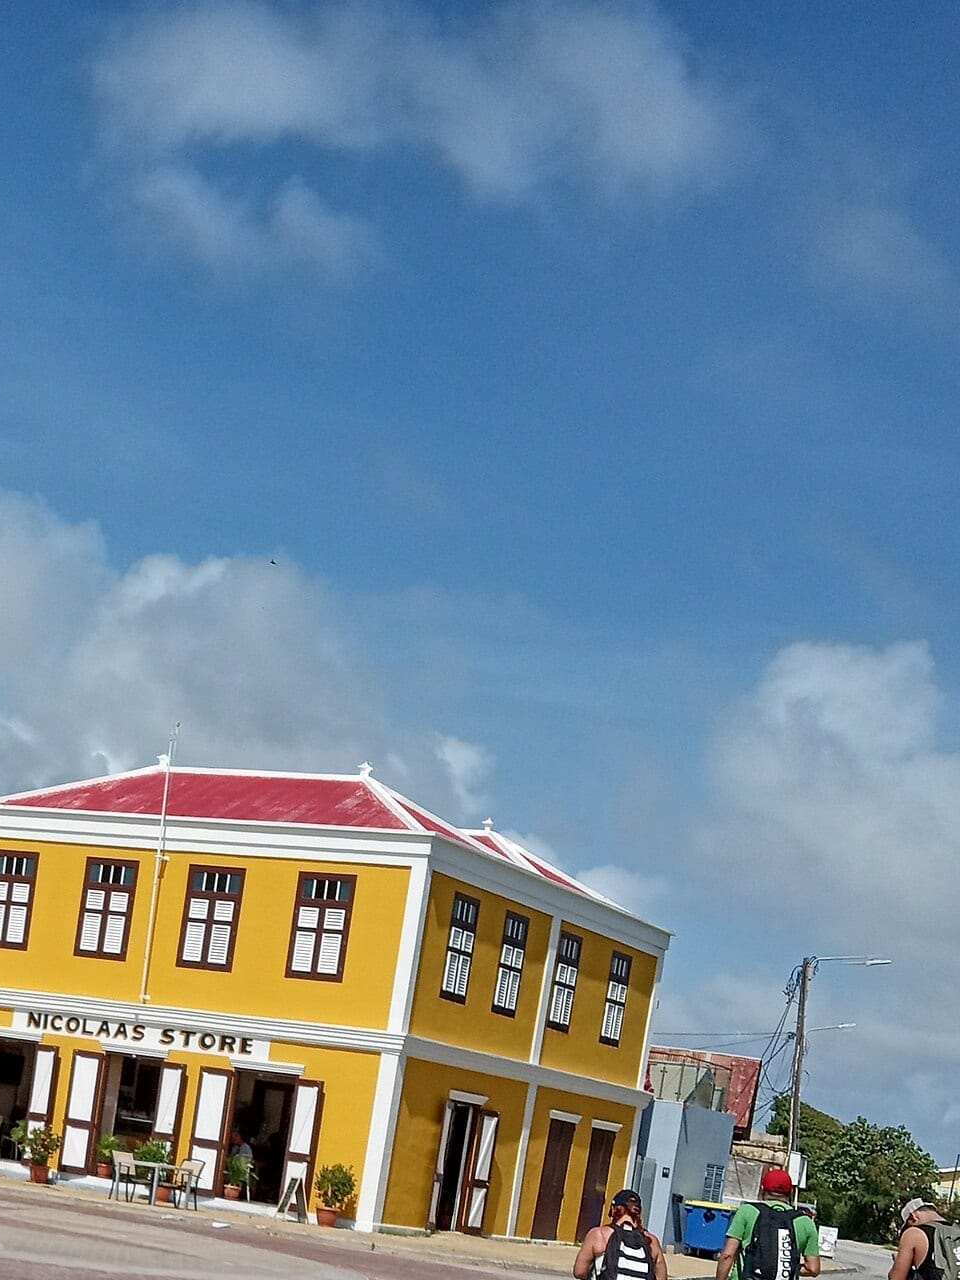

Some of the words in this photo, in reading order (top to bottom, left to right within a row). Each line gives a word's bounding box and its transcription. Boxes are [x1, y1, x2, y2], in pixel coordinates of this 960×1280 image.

[26, 1011, 147, 1042] NICOLAAS
[159, 1028, 255, 1056] STORE
[781, 1234, 792, 1278] adidas
